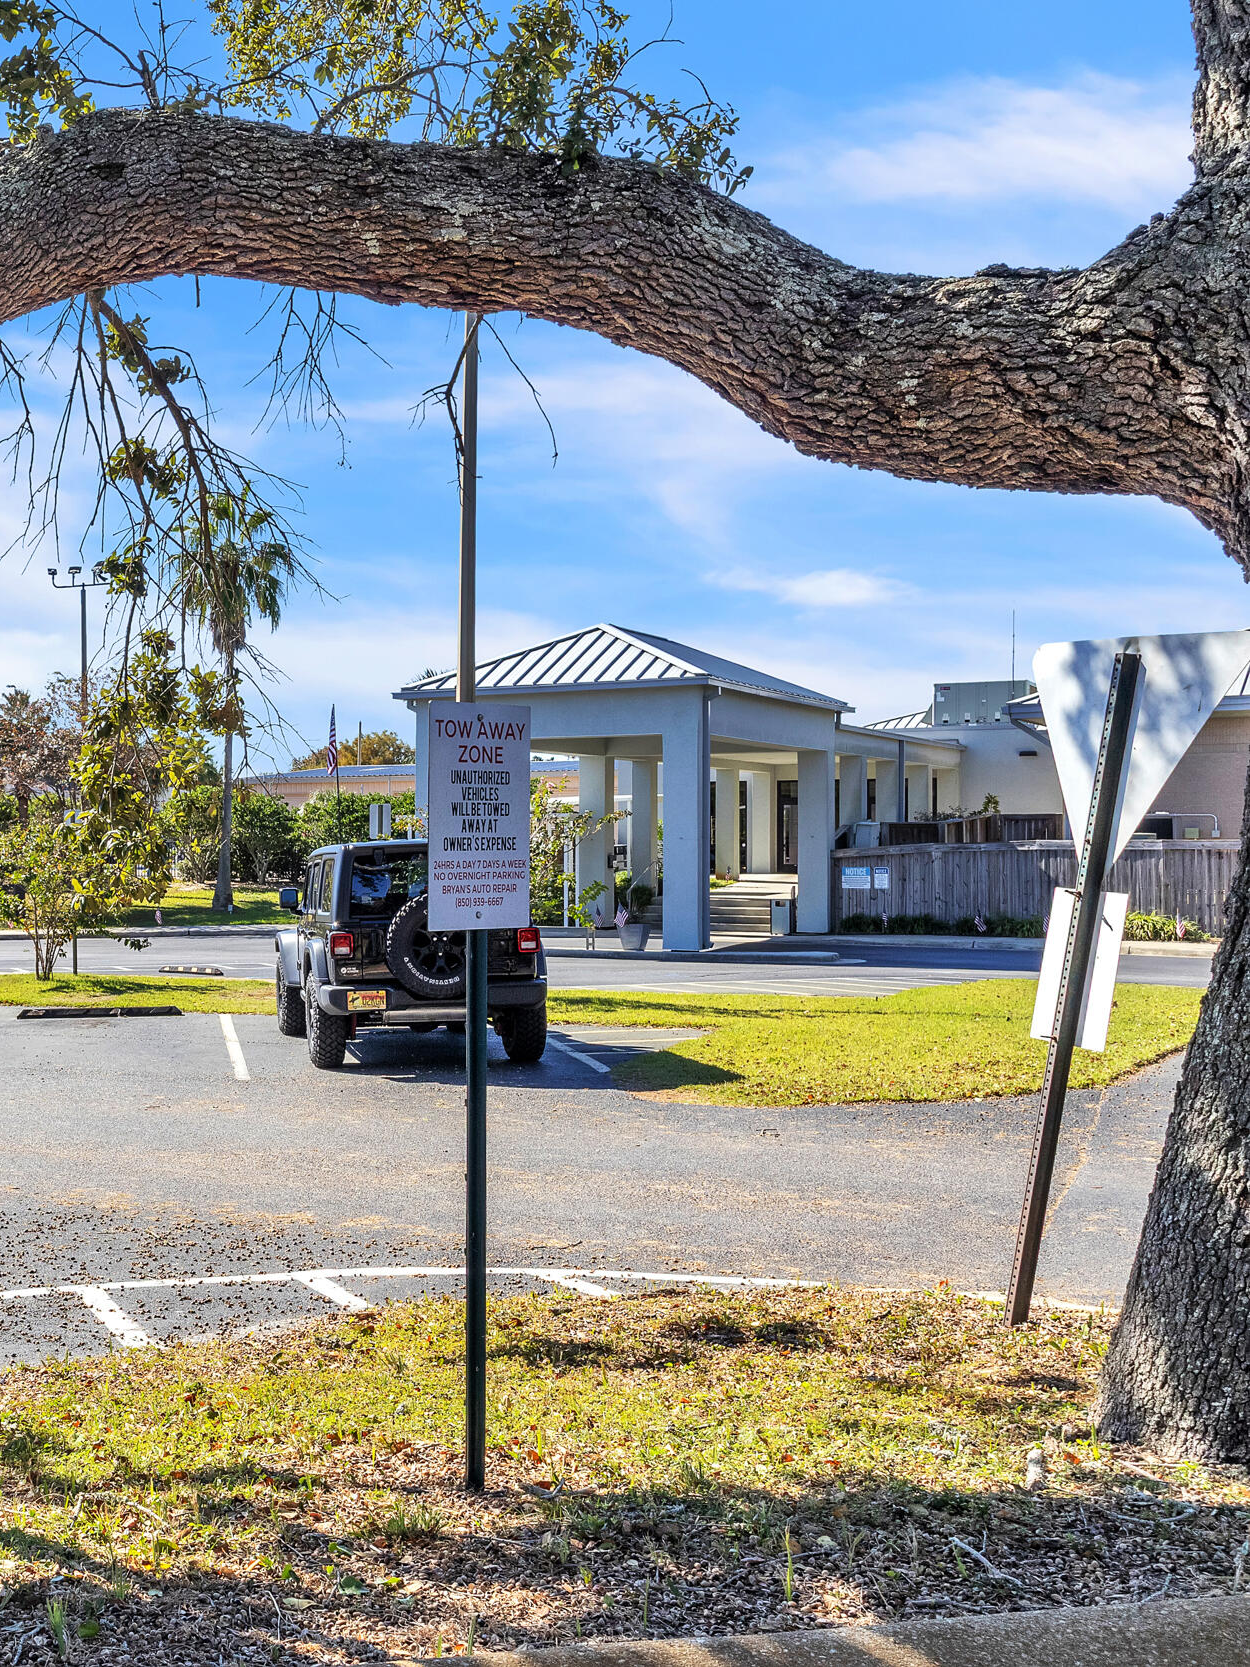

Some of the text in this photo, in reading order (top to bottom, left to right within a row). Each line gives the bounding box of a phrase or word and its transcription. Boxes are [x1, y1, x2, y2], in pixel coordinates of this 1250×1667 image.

[435, 719, 526, 741] TOW AWAY
[458, 745, 504, 764] ZONE
[450, 769, 511, 786] UNAUTHORIZED
[461, 786, 500, 802] VEHICLES
[451, 802, 510, 817] WILL BE TOWED
[461, 818, 499, 834] AWAY AT
[443, 834, 517, 852] OWNER'S EXPENSE
[433, 859, 527, 870] 24HRS A DAY 7 DAYS A WEEK
[845, 868, 867, 876] NOTICE
[433, 870, 526, 881] NO OVERNIGHT PARKING
[442, 883, 518, 895] BRYAN'S AUTO REPAIR
[455, 896, 504, 908] (850) 939-6667
